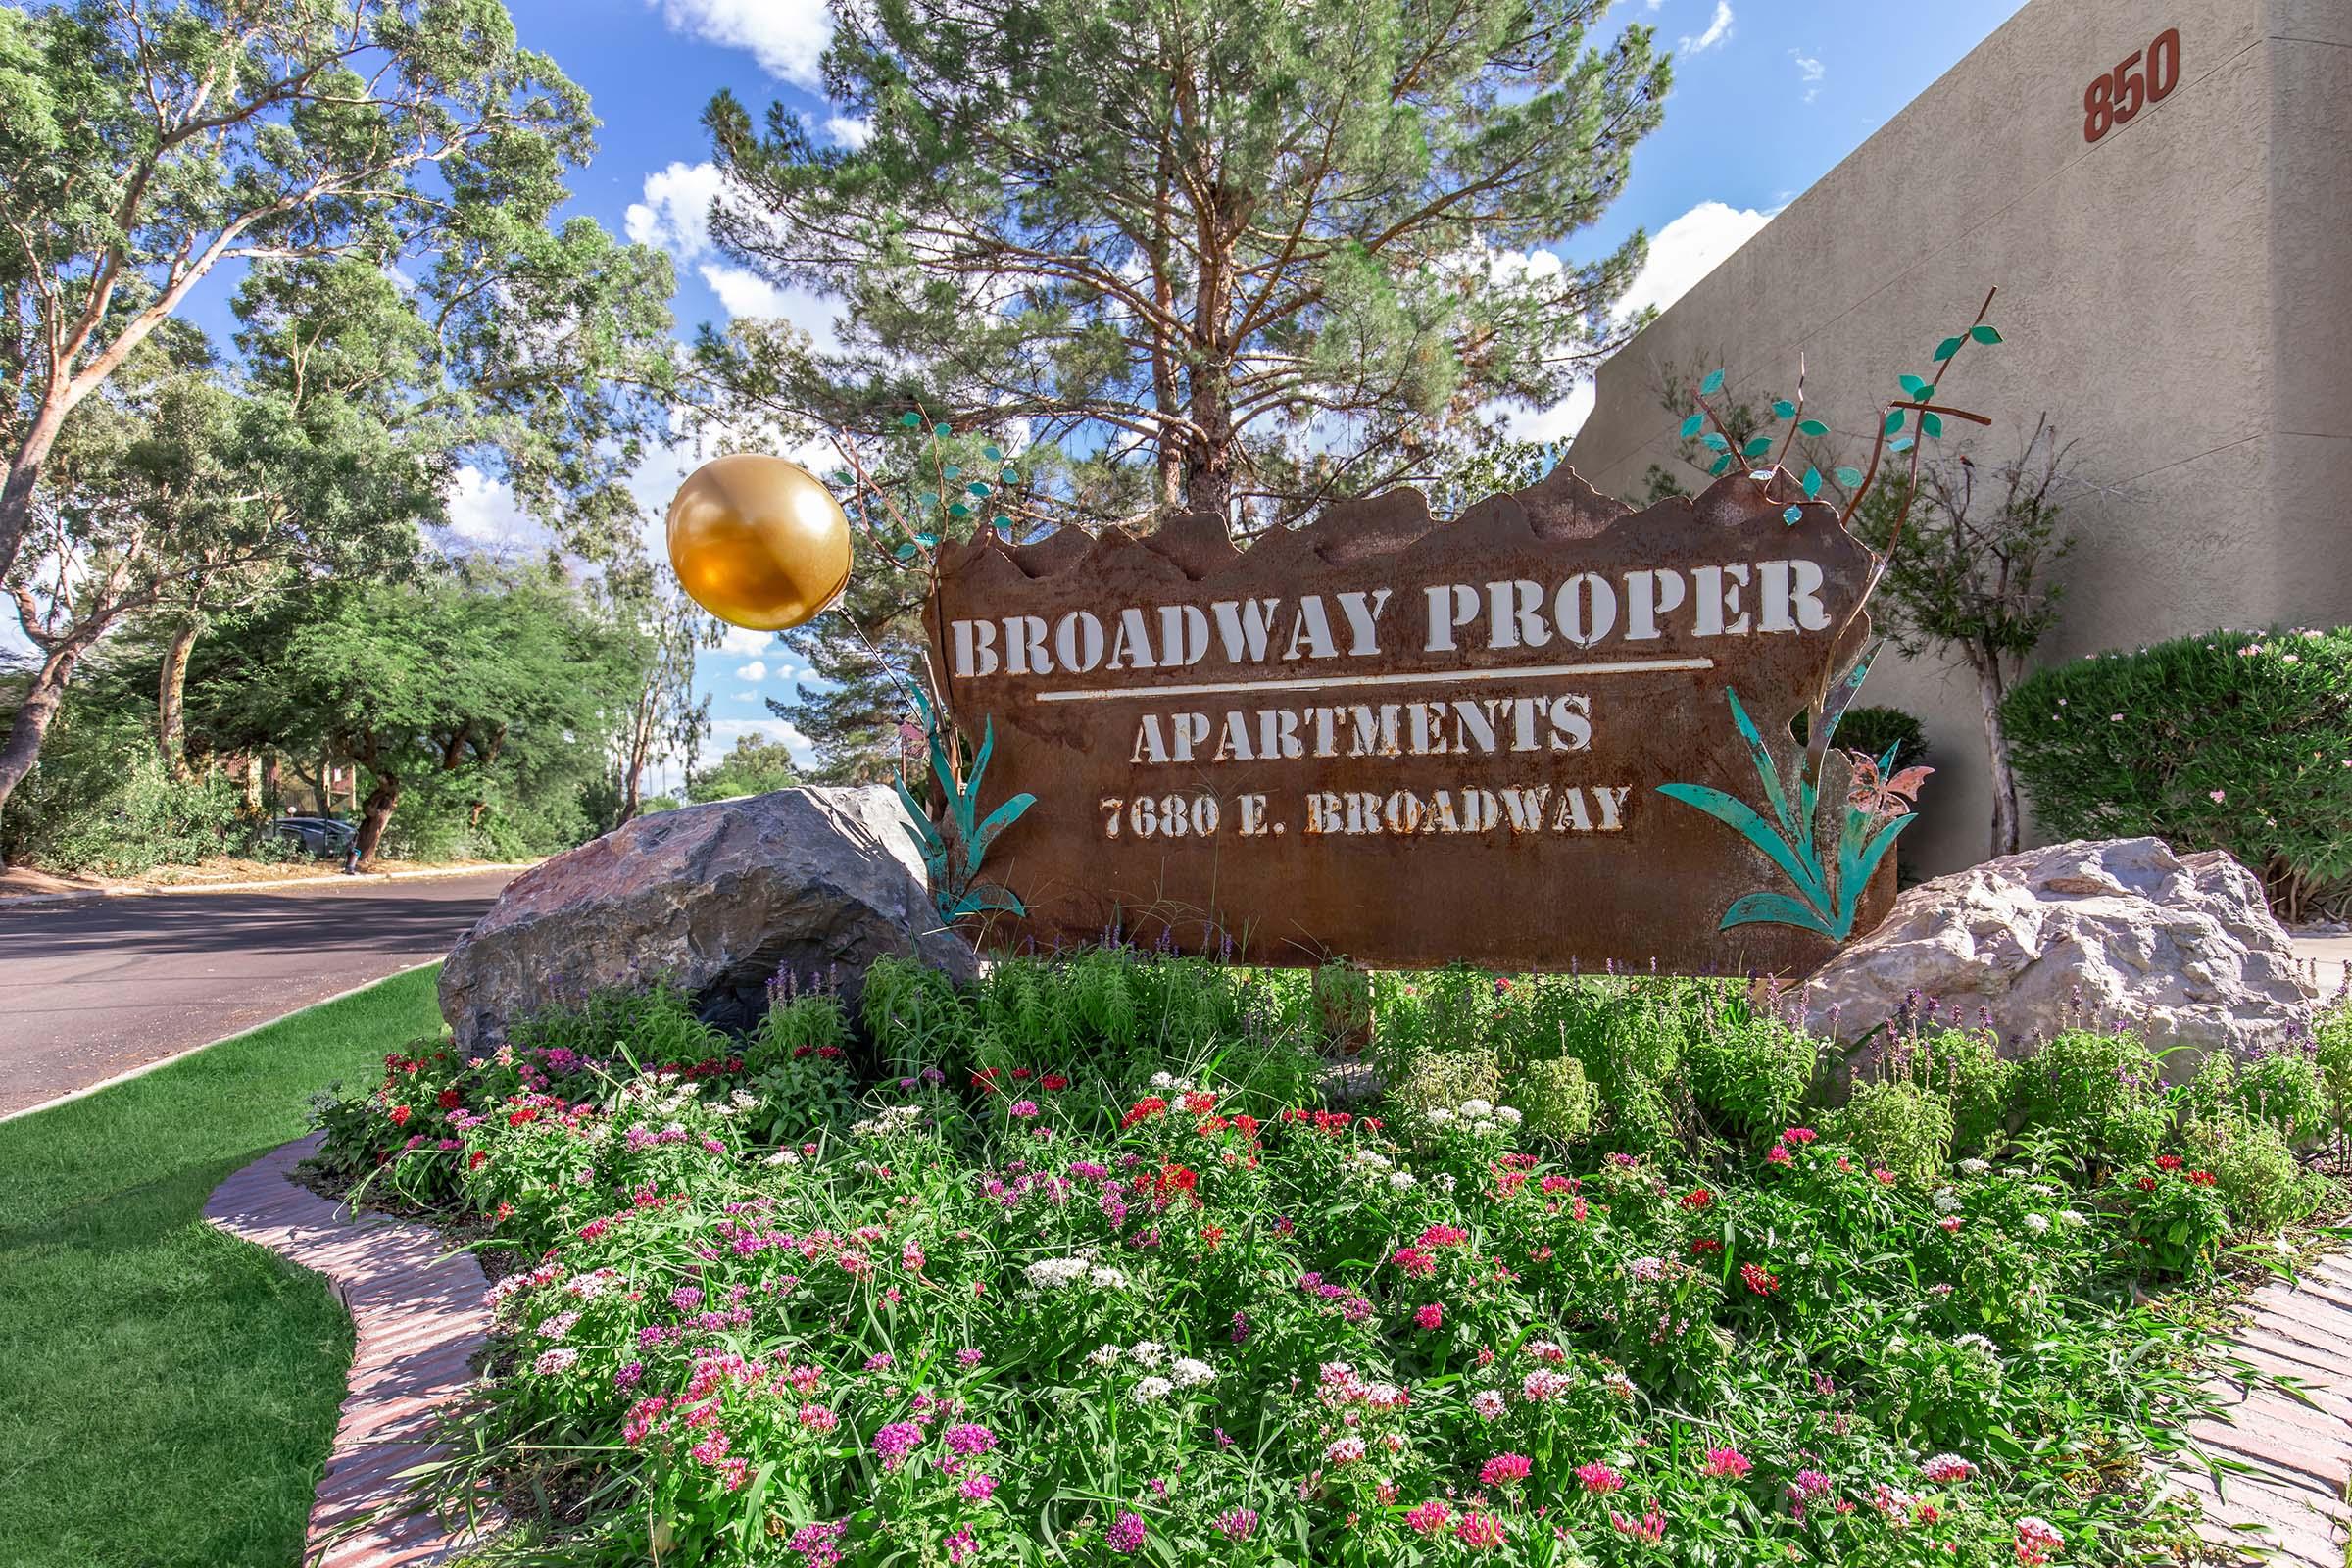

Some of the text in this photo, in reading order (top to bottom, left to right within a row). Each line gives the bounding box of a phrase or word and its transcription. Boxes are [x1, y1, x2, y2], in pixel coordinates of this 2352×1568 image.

[2084, 27, 2180, 143] 850
[951, 560, 1833, 678] BROADWAY PROPER
[1128, 693, 1592, 764] APARTMENTS
[1100, 783, 1633, 839] 7680 E. BROADWAY
